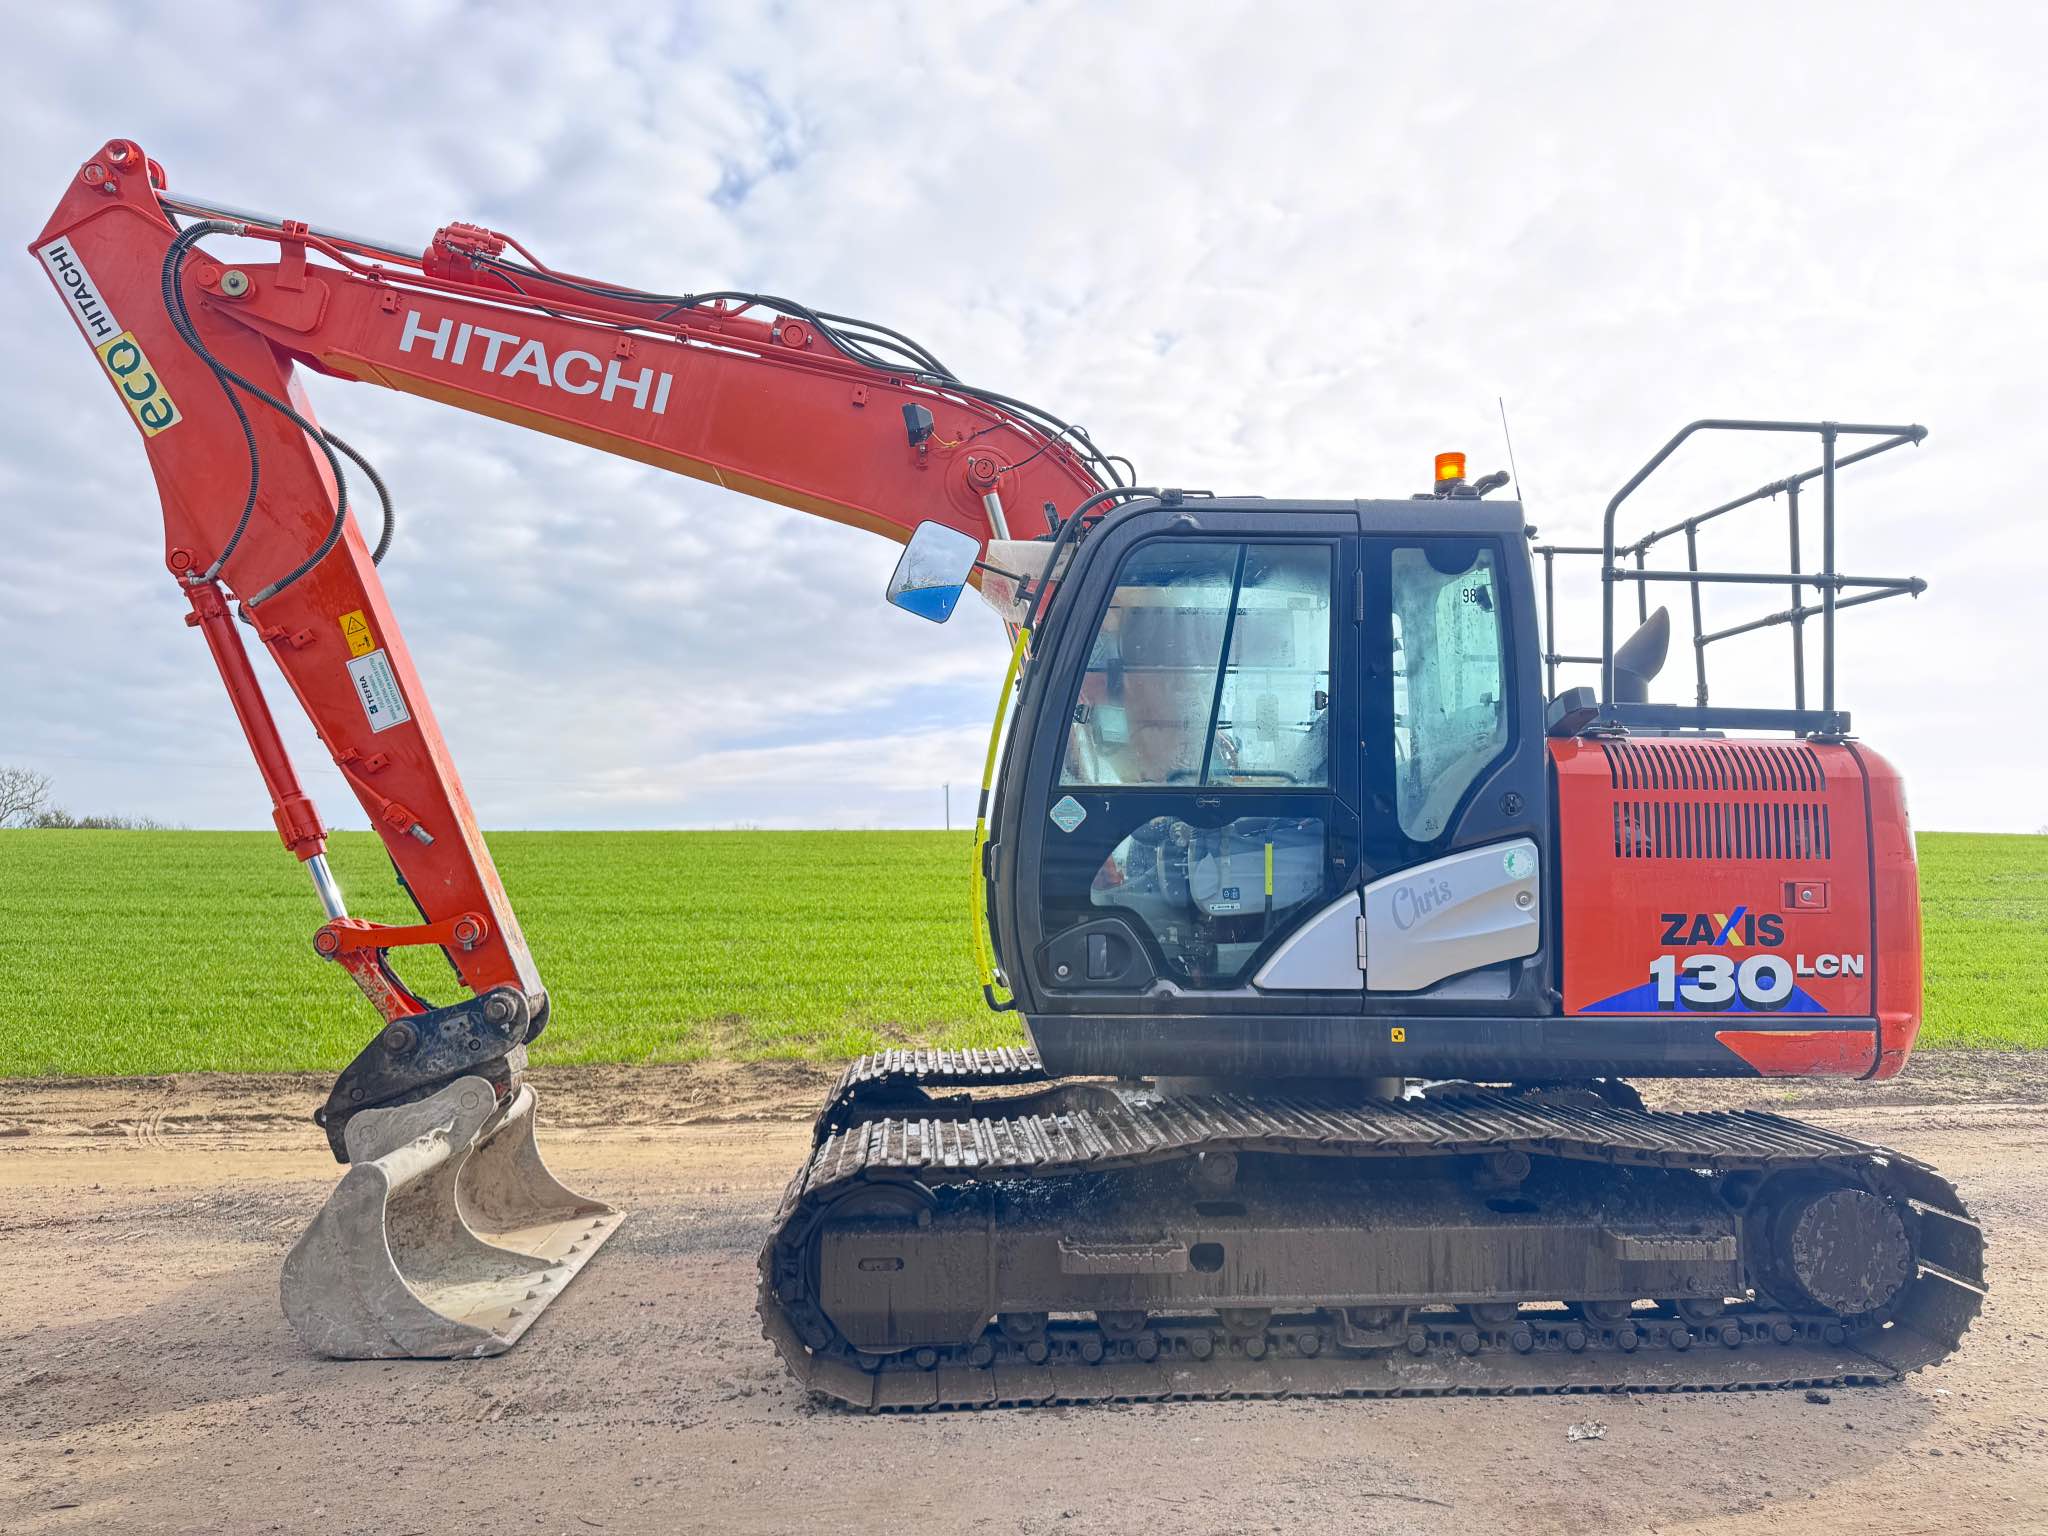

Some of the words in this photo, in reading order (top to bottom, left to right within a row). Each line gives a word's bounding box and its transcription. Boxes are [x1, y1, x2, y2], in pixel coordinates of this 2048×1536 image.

[49, 245, 112, 337] HITACHI
[107, 339, 174, 429] eco
[399, 310, 673, 415] HITACHI
[360, 676, 374, 704] TEFRA
[1391, 878, 1452, 930] Chris
[1660, 906, 1785, 946] ZAXIS
[1650, 954, 1794, 1010] 130
[1796, 954, 1864, 977] LCN
